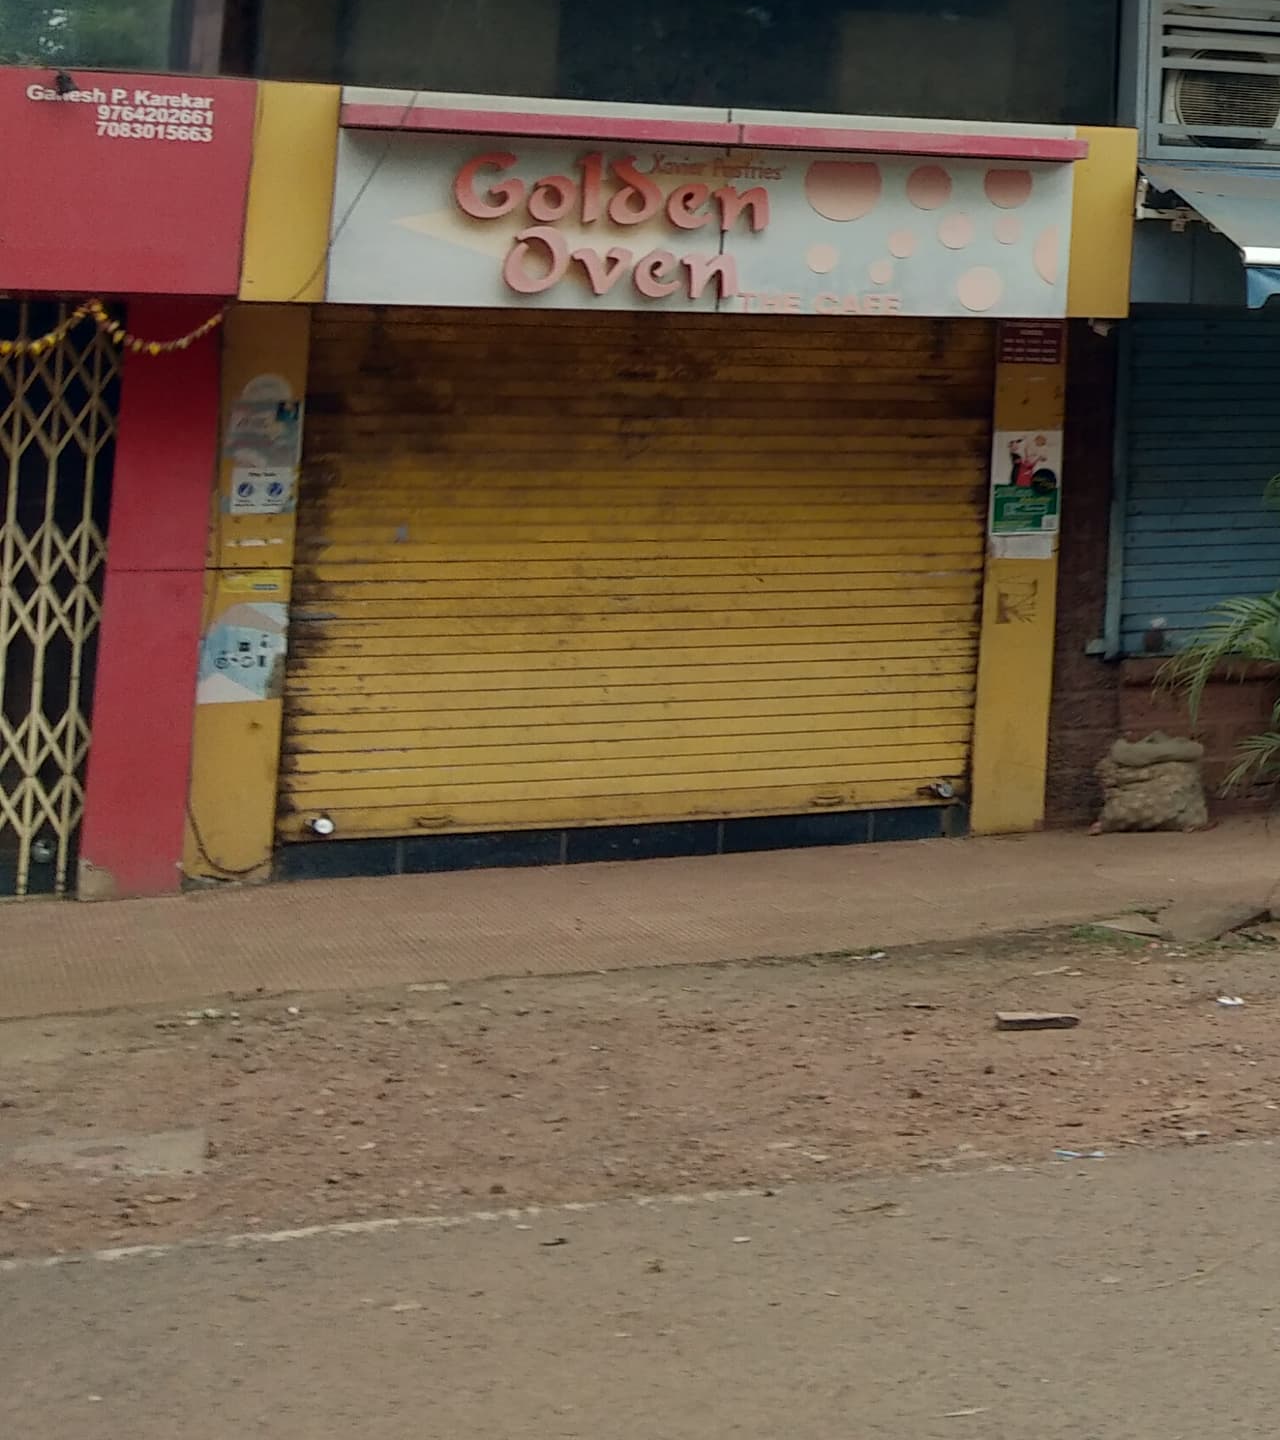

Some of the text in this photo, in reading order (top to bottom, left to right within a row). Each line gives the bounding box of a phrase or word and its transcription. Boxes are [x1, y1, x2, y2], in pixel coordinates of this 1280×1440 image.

[111, 88, 130, 105] P.
[134, 89, 215, 109] Karekar
[97, 104, 214, 126] 9764202661
[95, 120, 213, 142] 7083015663
[454, 151, 771, 232] Golden
[502, 225, 739, 299] Oven
